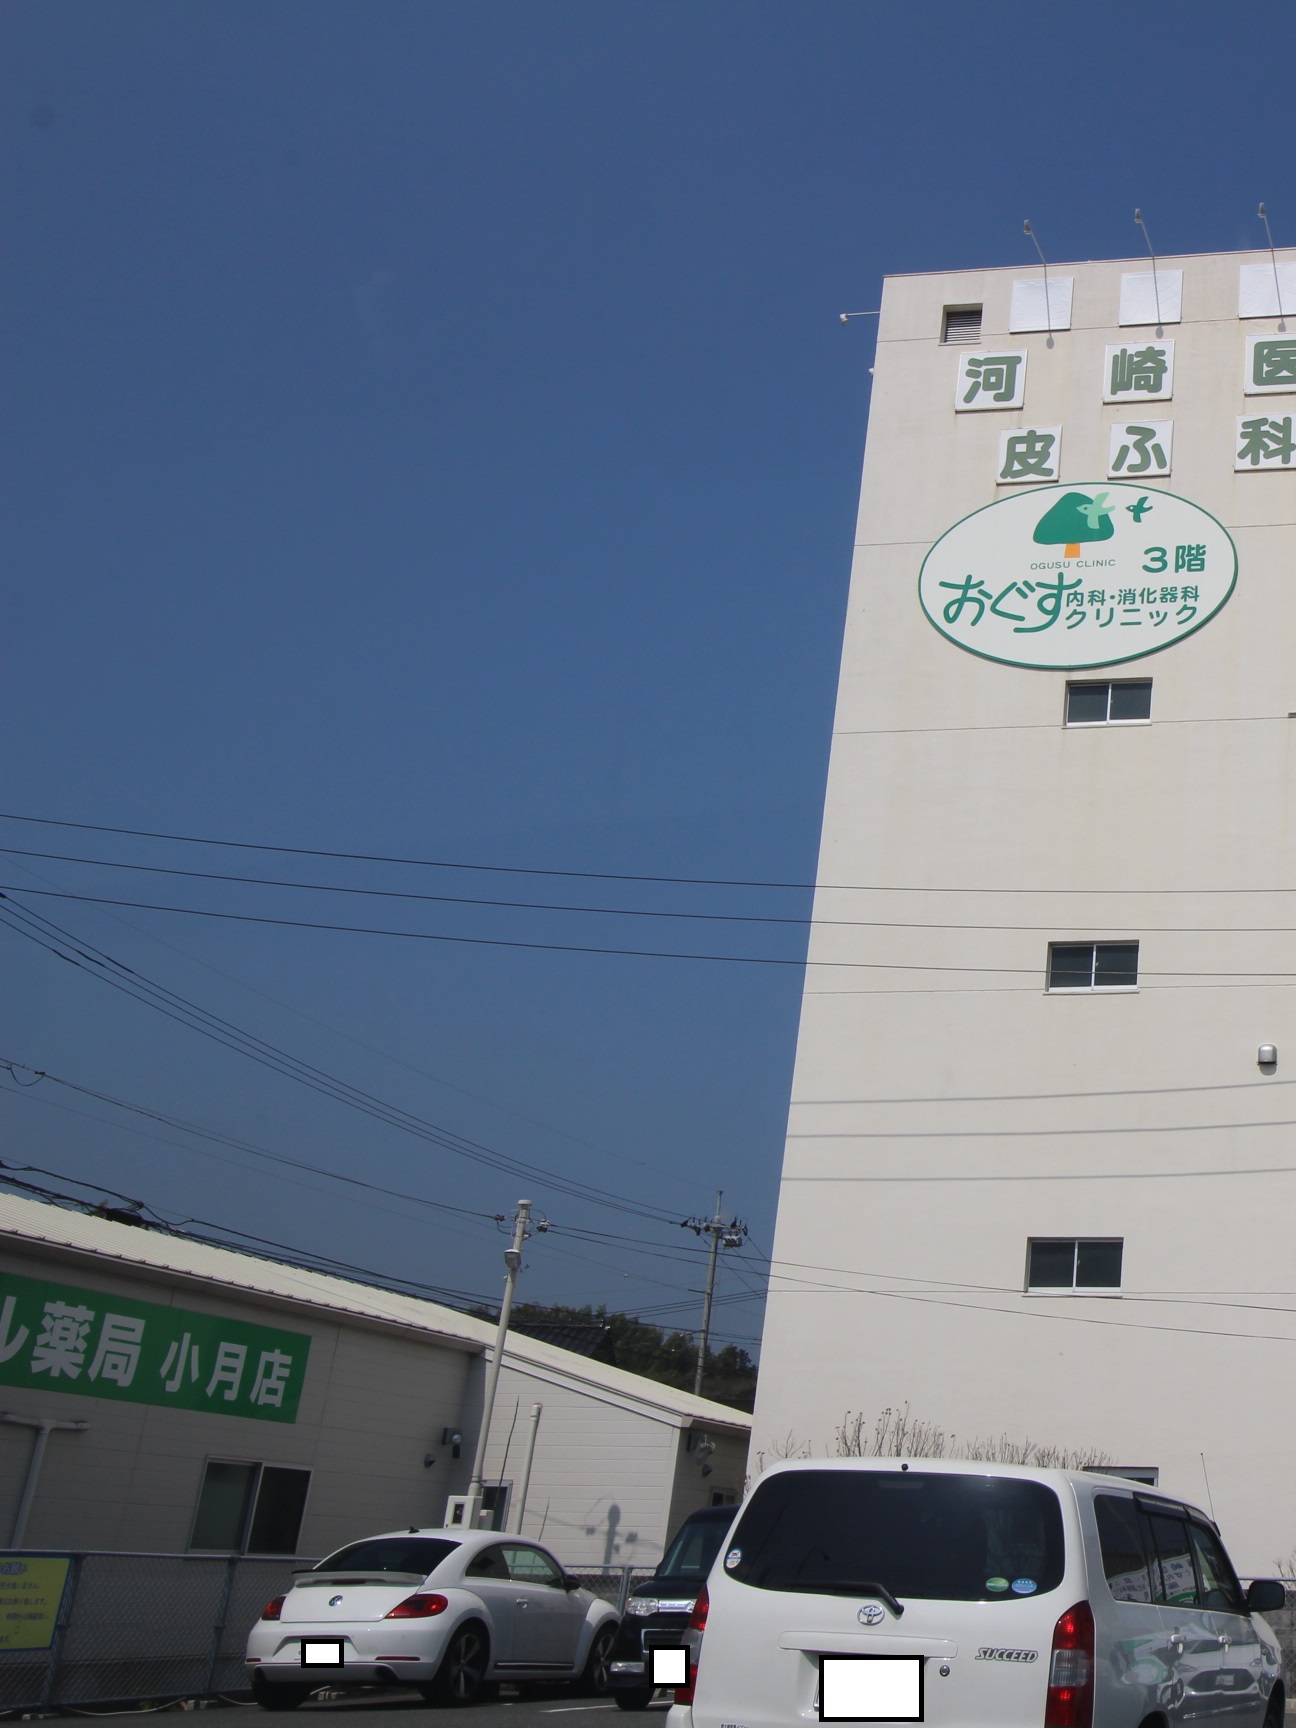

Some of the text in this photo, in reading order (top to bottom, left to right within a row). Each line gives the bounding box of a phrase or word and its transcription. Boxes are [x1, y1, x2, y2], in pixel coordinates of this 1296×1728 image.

[1000, 416, 1296, 479] 皮ふ科
[1030, 559, 1116, 570] OGUSU CLINIC
[1142, 544, 1206, 573] 3階
[939, 572, 1083, 633] おぐす
[1066, 585, 1200, 607] 内科・消化器科
[1066, 604, 1197, 629] クリニック
[160, 1332, 293, 1407] 小月店
[975, 1647, 1039, 1663] SUCCEED
